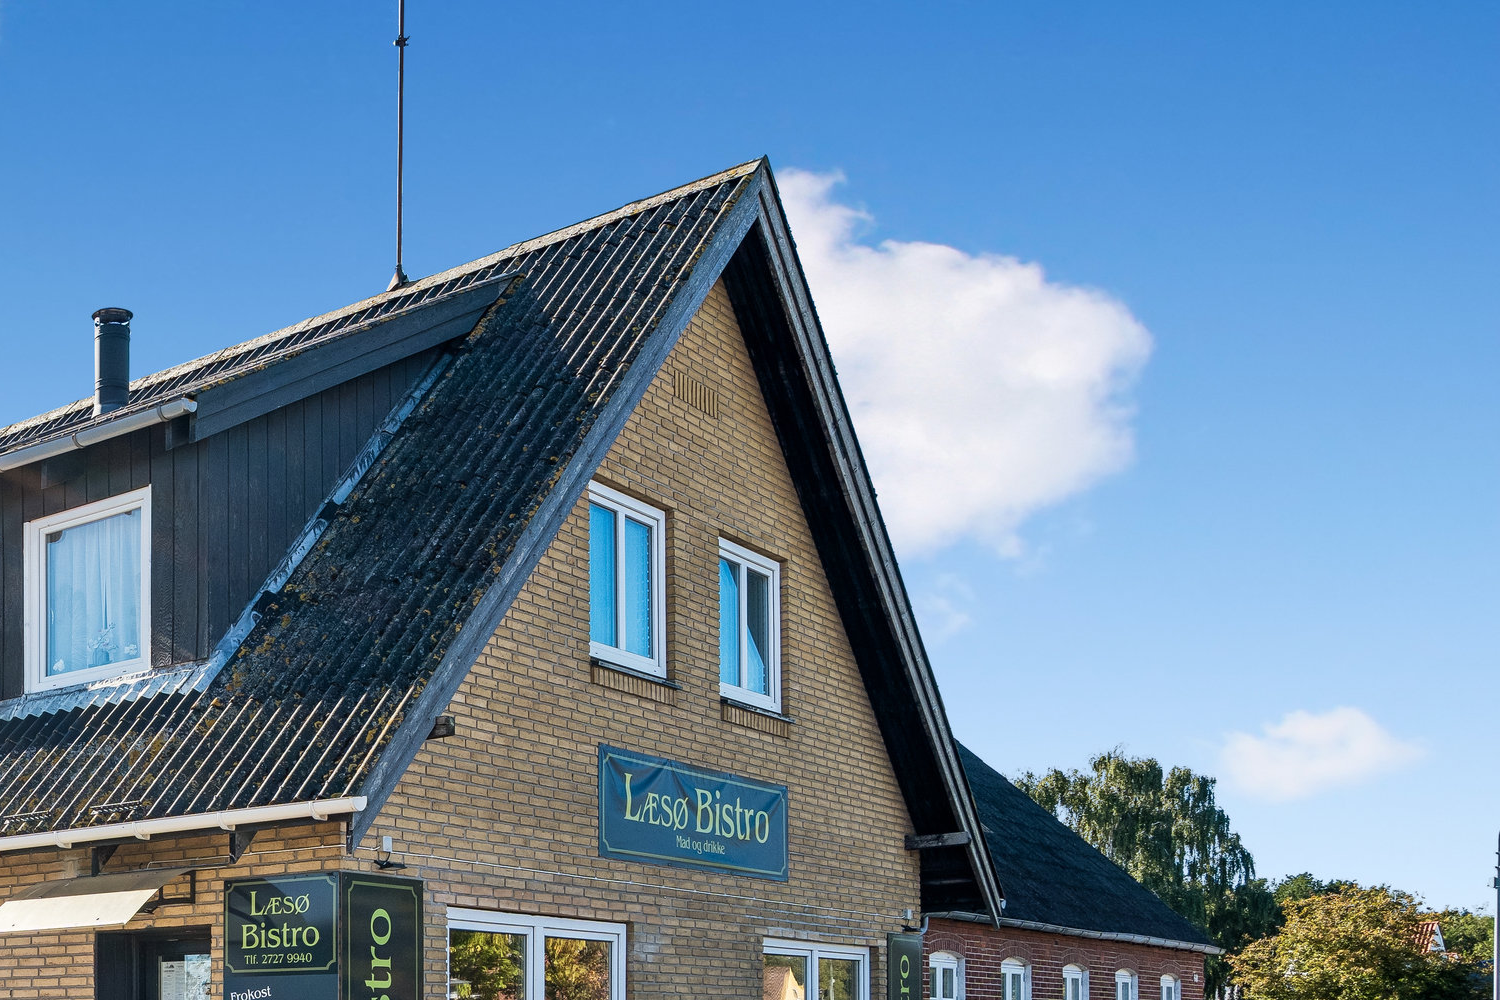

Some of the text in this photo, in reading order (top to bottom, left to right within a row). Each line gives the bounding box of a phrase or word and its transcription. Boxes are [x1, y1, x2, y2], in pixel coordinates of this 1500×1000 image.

[694, 787, 769, 844] Bistro
[676, 834, 726, 855] Mad og drikke
[241, 922, 320, 949] Bistro
[244, 952, 313, 965] Tlf. 2727 9940
